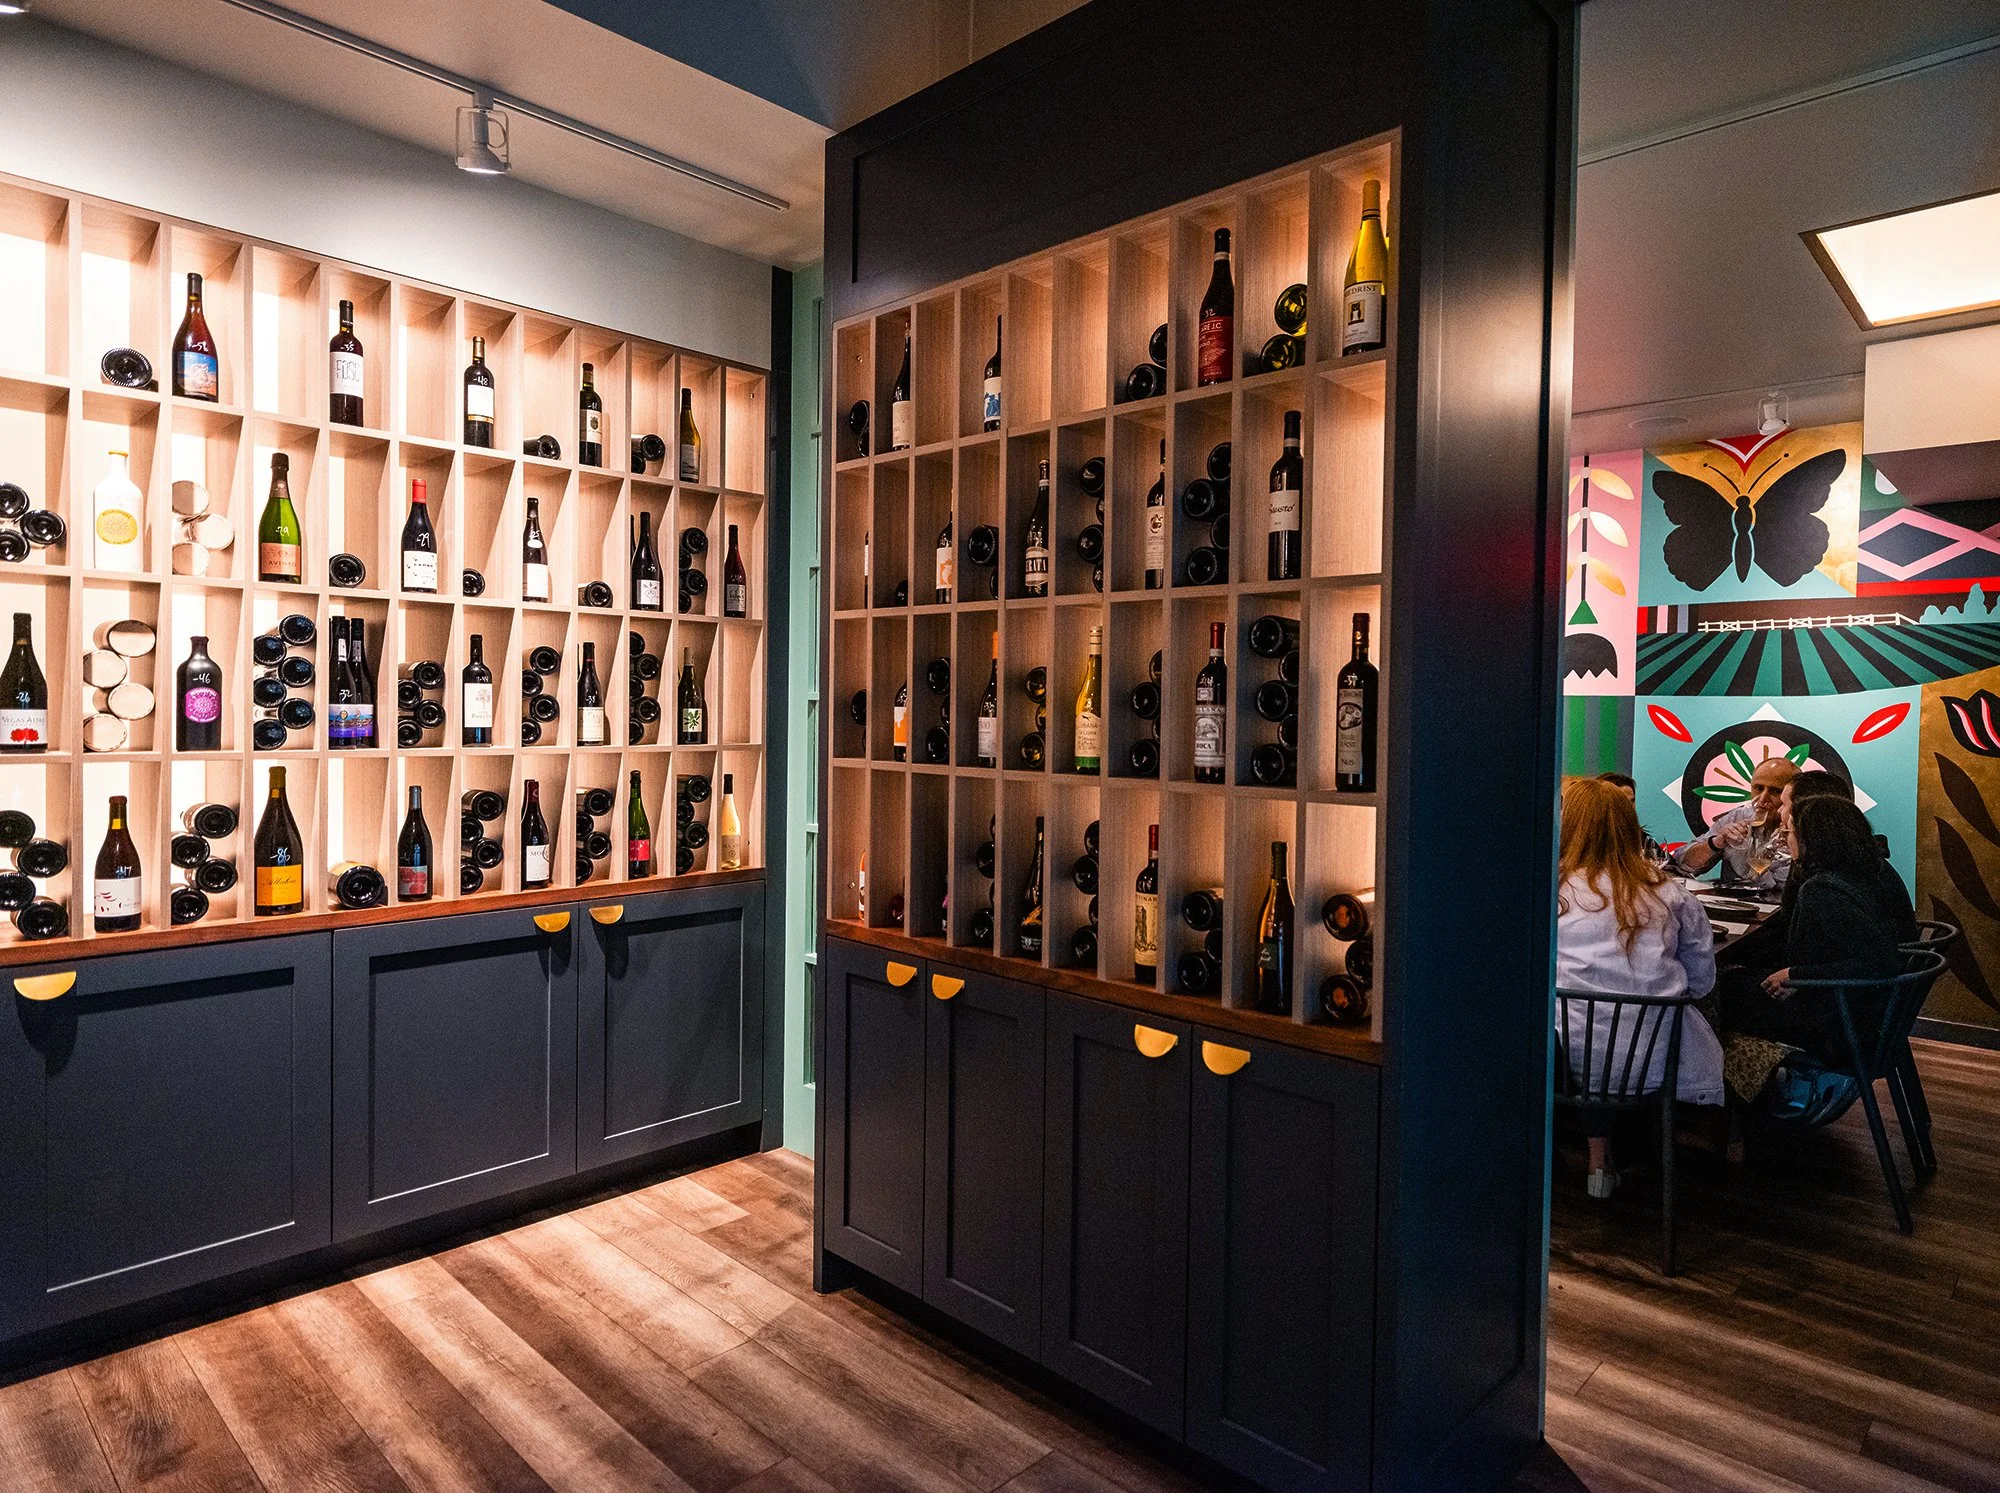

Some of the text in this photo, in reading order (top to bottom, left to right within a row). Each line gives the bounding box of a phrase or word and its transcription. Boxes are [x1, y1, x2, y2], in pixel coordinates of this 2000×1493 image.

[192, 672, 212, 684] -46
[15, 691, 31, 703] -26
[270, 847, 291, 863] -86
